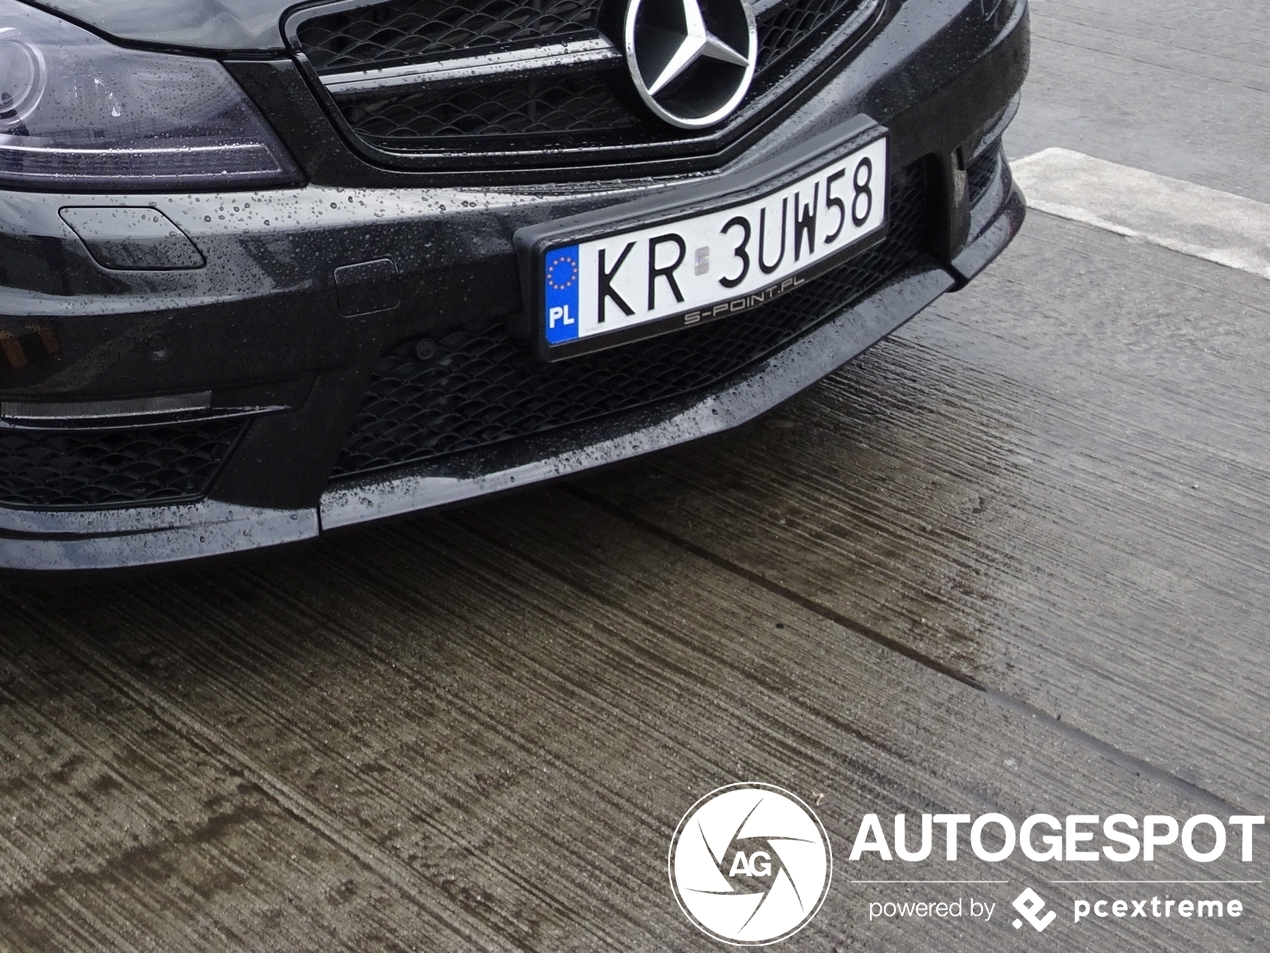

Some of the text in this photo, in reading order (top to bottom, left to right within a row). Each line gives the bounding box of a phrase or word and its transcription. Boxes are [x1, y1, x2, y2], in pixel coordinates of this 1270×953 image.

[597, 156, 873, 324] KR 3UW58
[550, 305, 575, 328] PL
[684, 276, 806, 325] S-POINT.PL
